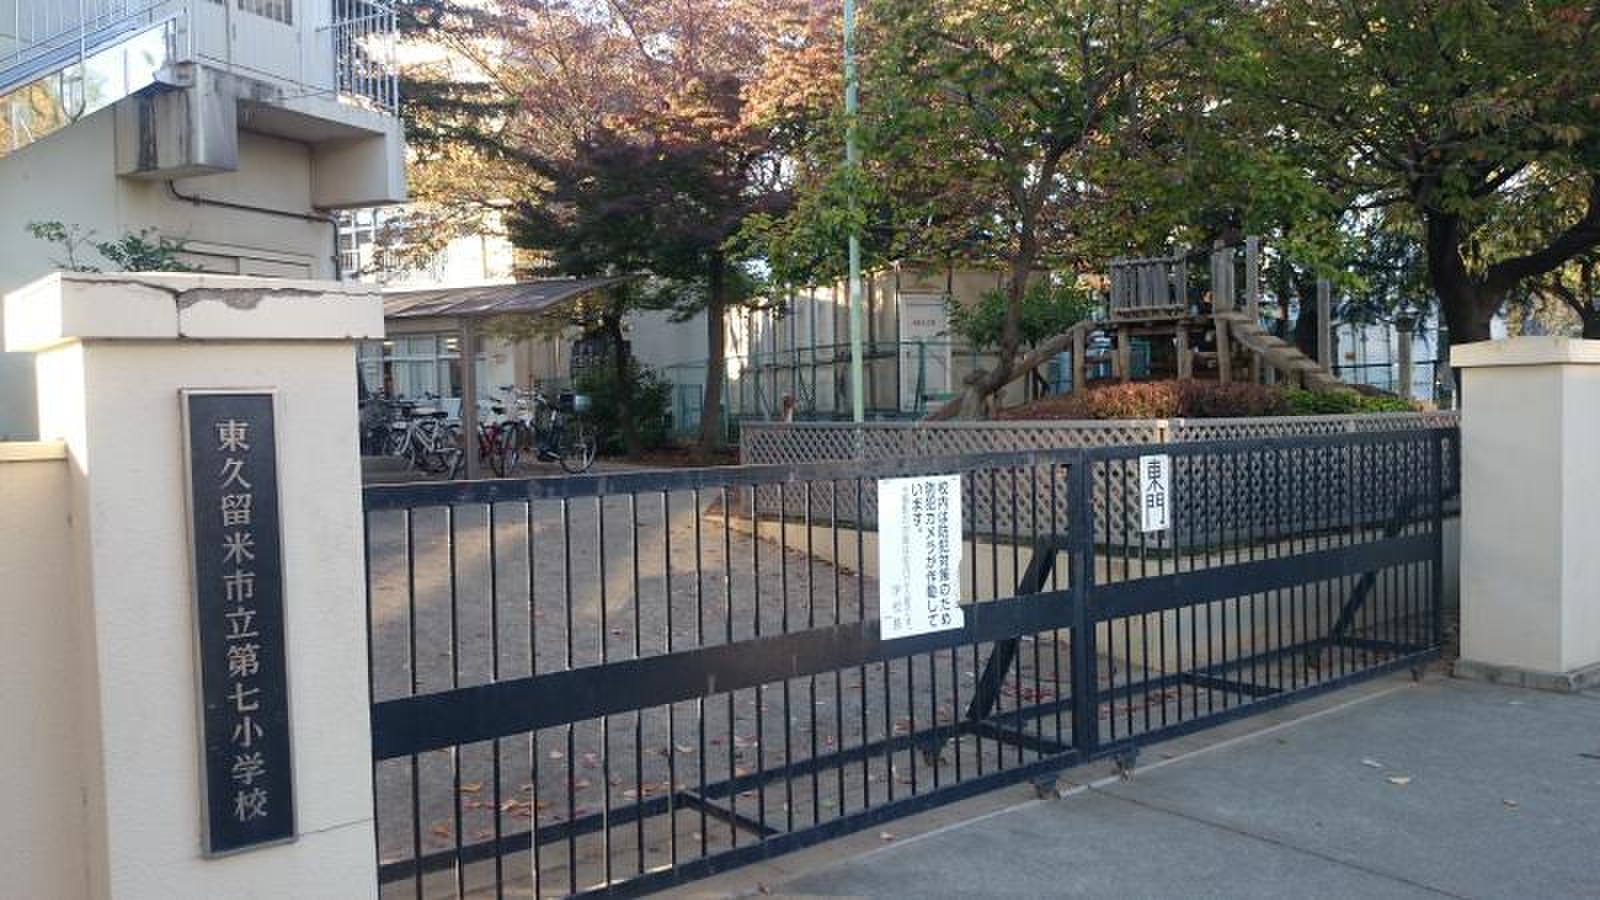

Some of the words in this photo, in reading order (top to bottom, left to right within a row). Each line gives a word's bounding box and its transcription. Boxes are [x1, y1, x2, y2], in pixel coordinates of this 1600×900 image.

[1146, 457, 1165, 524] 東門
[216, 418, 267, 822] 東久留米市立第七小学校
